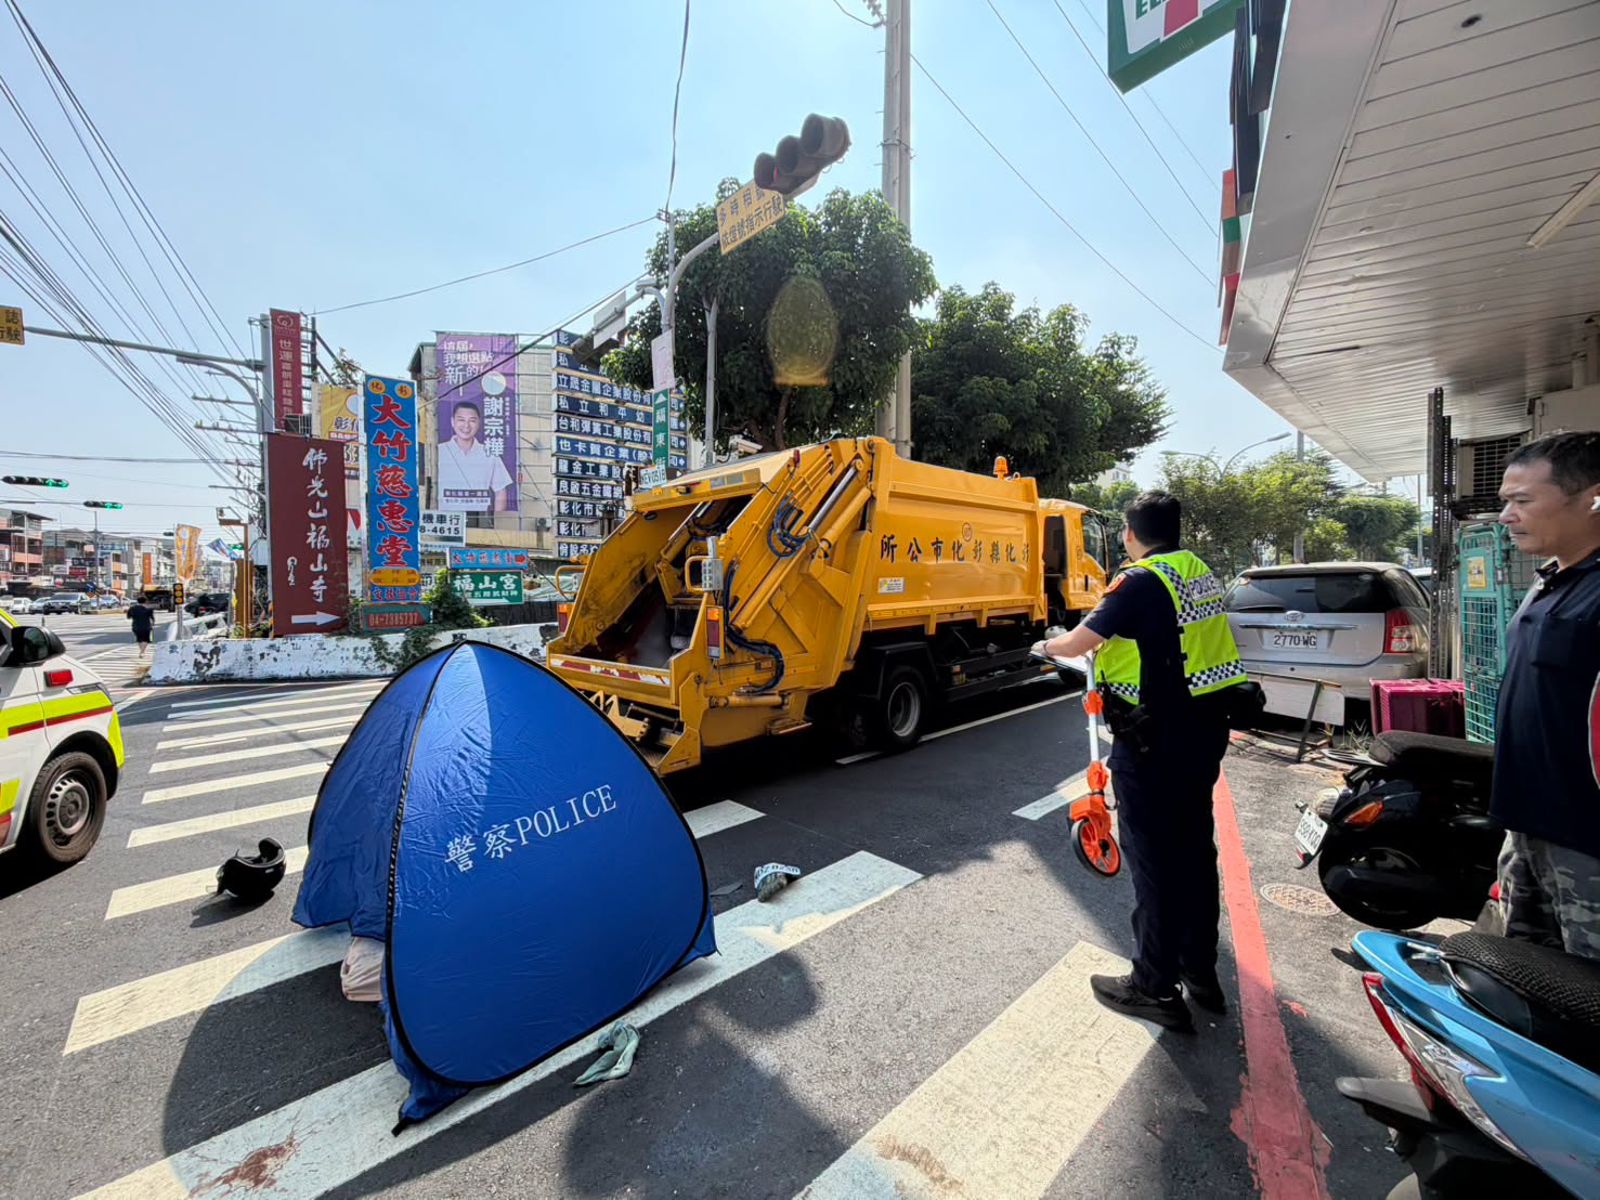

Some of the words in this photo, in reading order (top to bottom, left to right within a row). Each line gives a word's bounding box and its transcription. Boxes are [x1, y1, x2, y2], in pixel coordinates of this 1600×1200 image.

[370, 393, 414, 567] 大竹慈惠堂
[422, 513, 461, 526] 機車行
[453, 573, 518, 591] 福山宮
[1273, 634, 1317, 647] 2770-WG
[444, 823, 517, 873] 警察
[513, 784, 617, 846] POLICE
